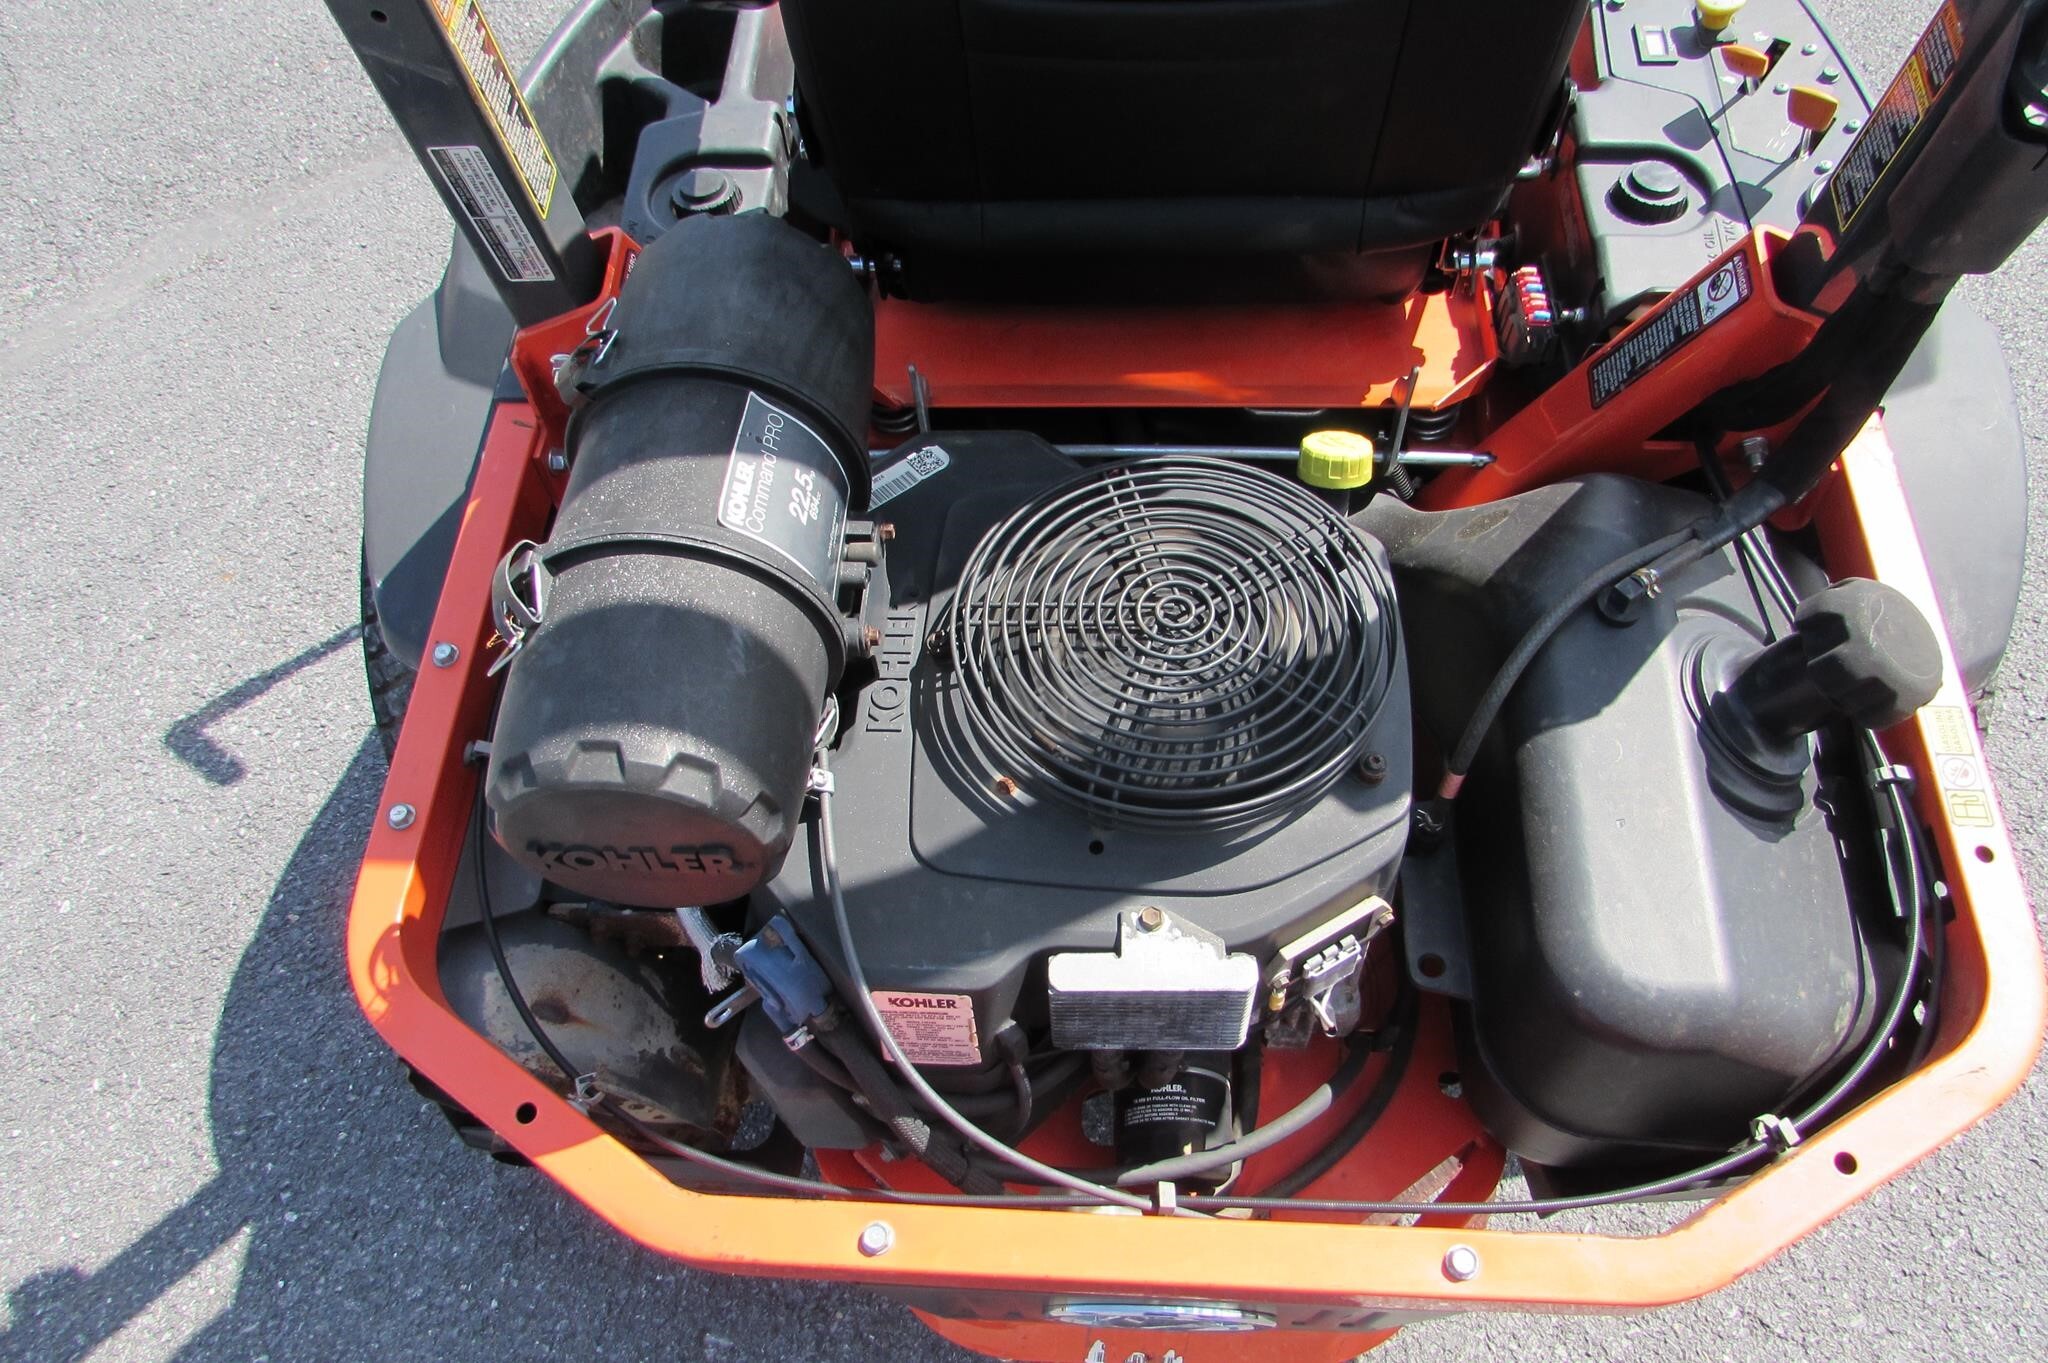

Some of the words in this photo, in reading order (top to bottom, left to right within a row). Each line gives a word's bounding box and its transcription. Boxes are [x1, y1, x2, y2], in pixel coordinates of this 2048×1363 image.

[1736, 262, 1748, 298] DANGER
[744, 450, 777, 533] Command
[763, 413, 784, 450] PRO
[726, 461, 754, 526] KOHLER
[527, 841, 737, 875] KOHLER
[888, 997, 958, 1009] KOHLER
